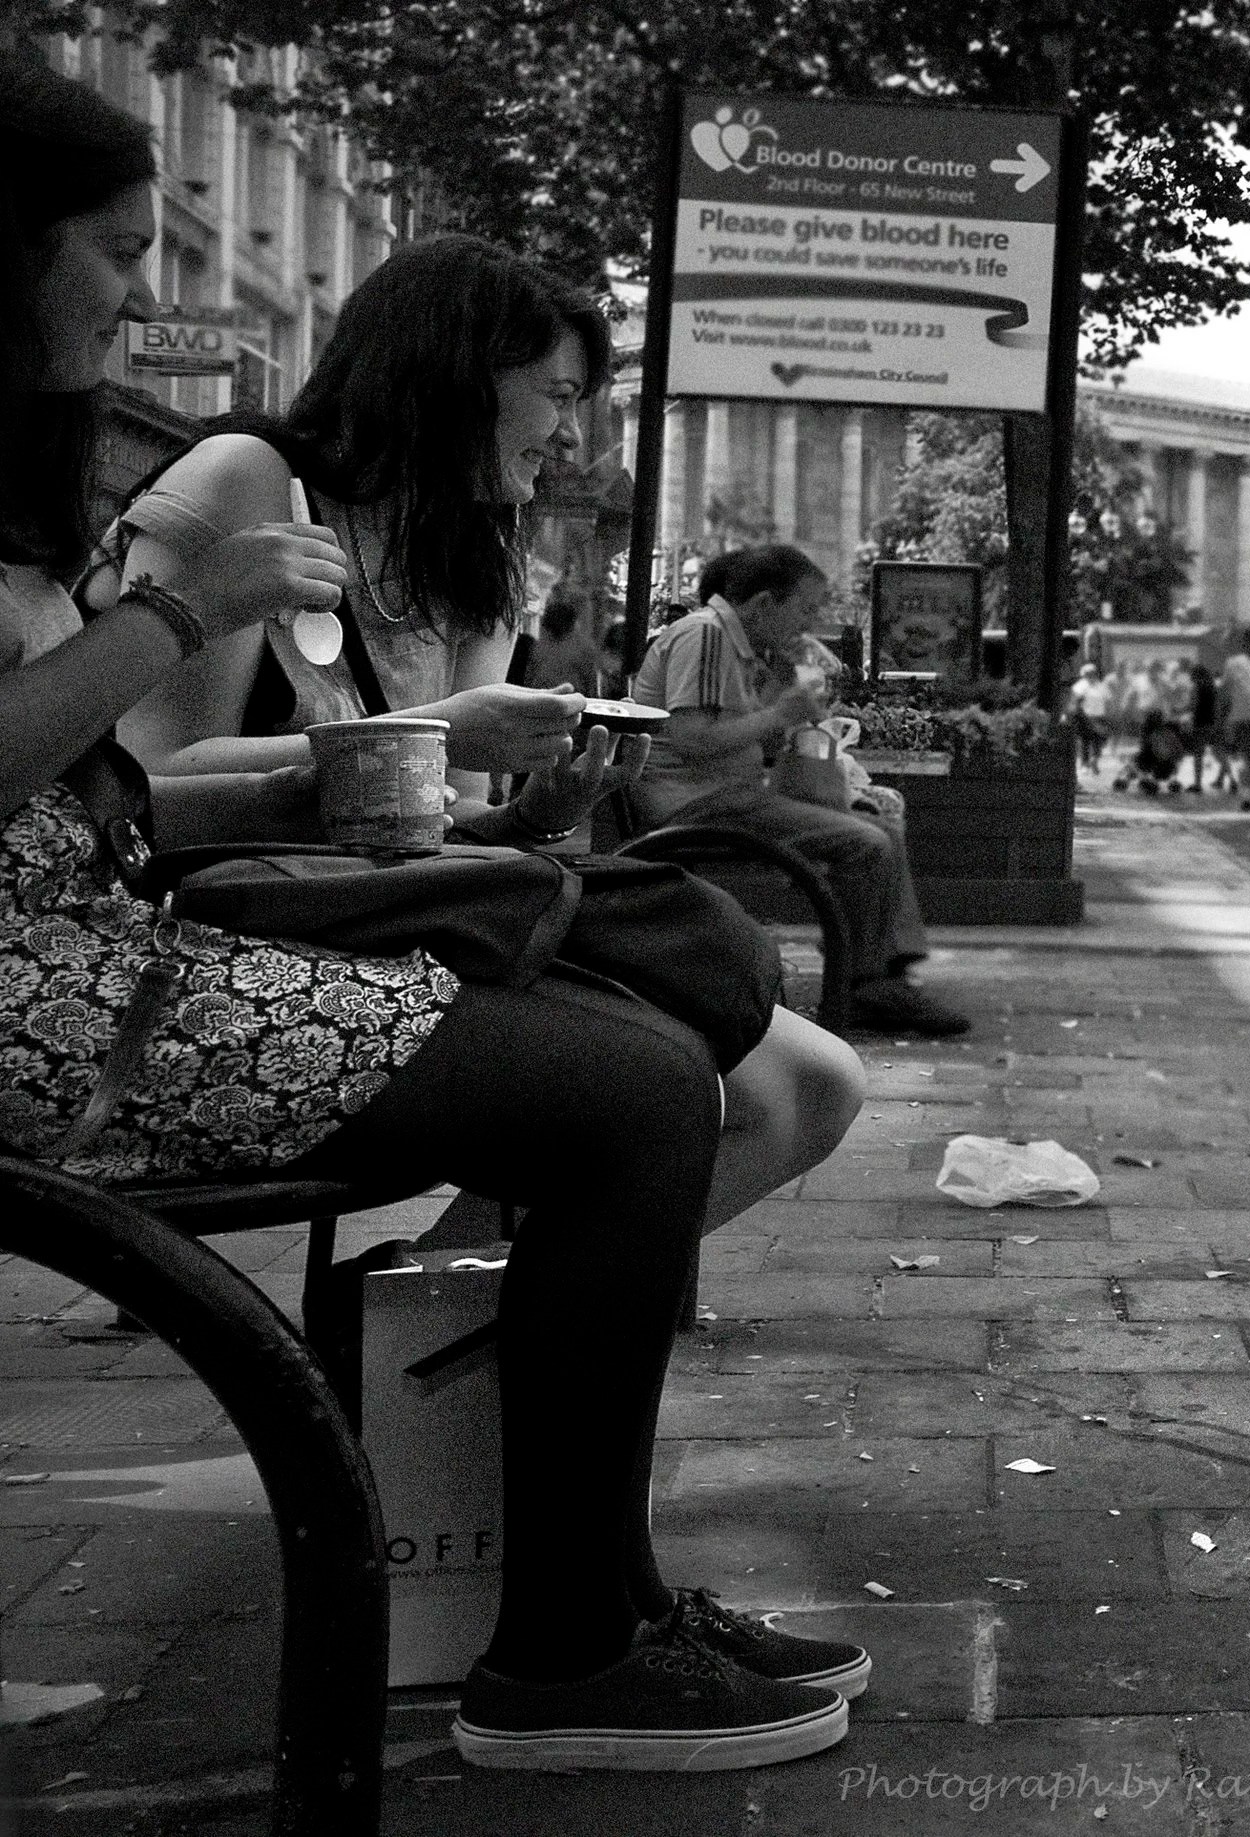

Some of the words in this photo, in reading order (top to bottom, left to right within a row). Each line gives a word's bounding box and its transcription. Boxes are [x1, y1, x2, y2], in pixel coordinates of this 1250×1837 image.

[756, 145, 820, 168] Blood
[827, 151, 898, 173] Donor
[904, 156, 977, 178] Centre
[767, 175, 799, 192] 2nd
[804, 177, 846, 195] Floor
[860, 182, 880, 197] 65
[885, 183, 922, 199] New
[927, 186, 976, 205] Street
[700, 208, 787, 237] Please
[793, 215, 854, 243] give
[861, 218, 940, 247] blood
[948, 223, 1010, 250] here
[709, 245, 749, 265] you
[753, 246, 811, 265] could
[816, 249, 861, 268] save
[864, 253, 971, 276] someone's
[976, 256, 1008, 279] life
[692, 308, 742, 326] When
[870, 319, 899, 337] 123
[925, 322, 945, 339] 23
